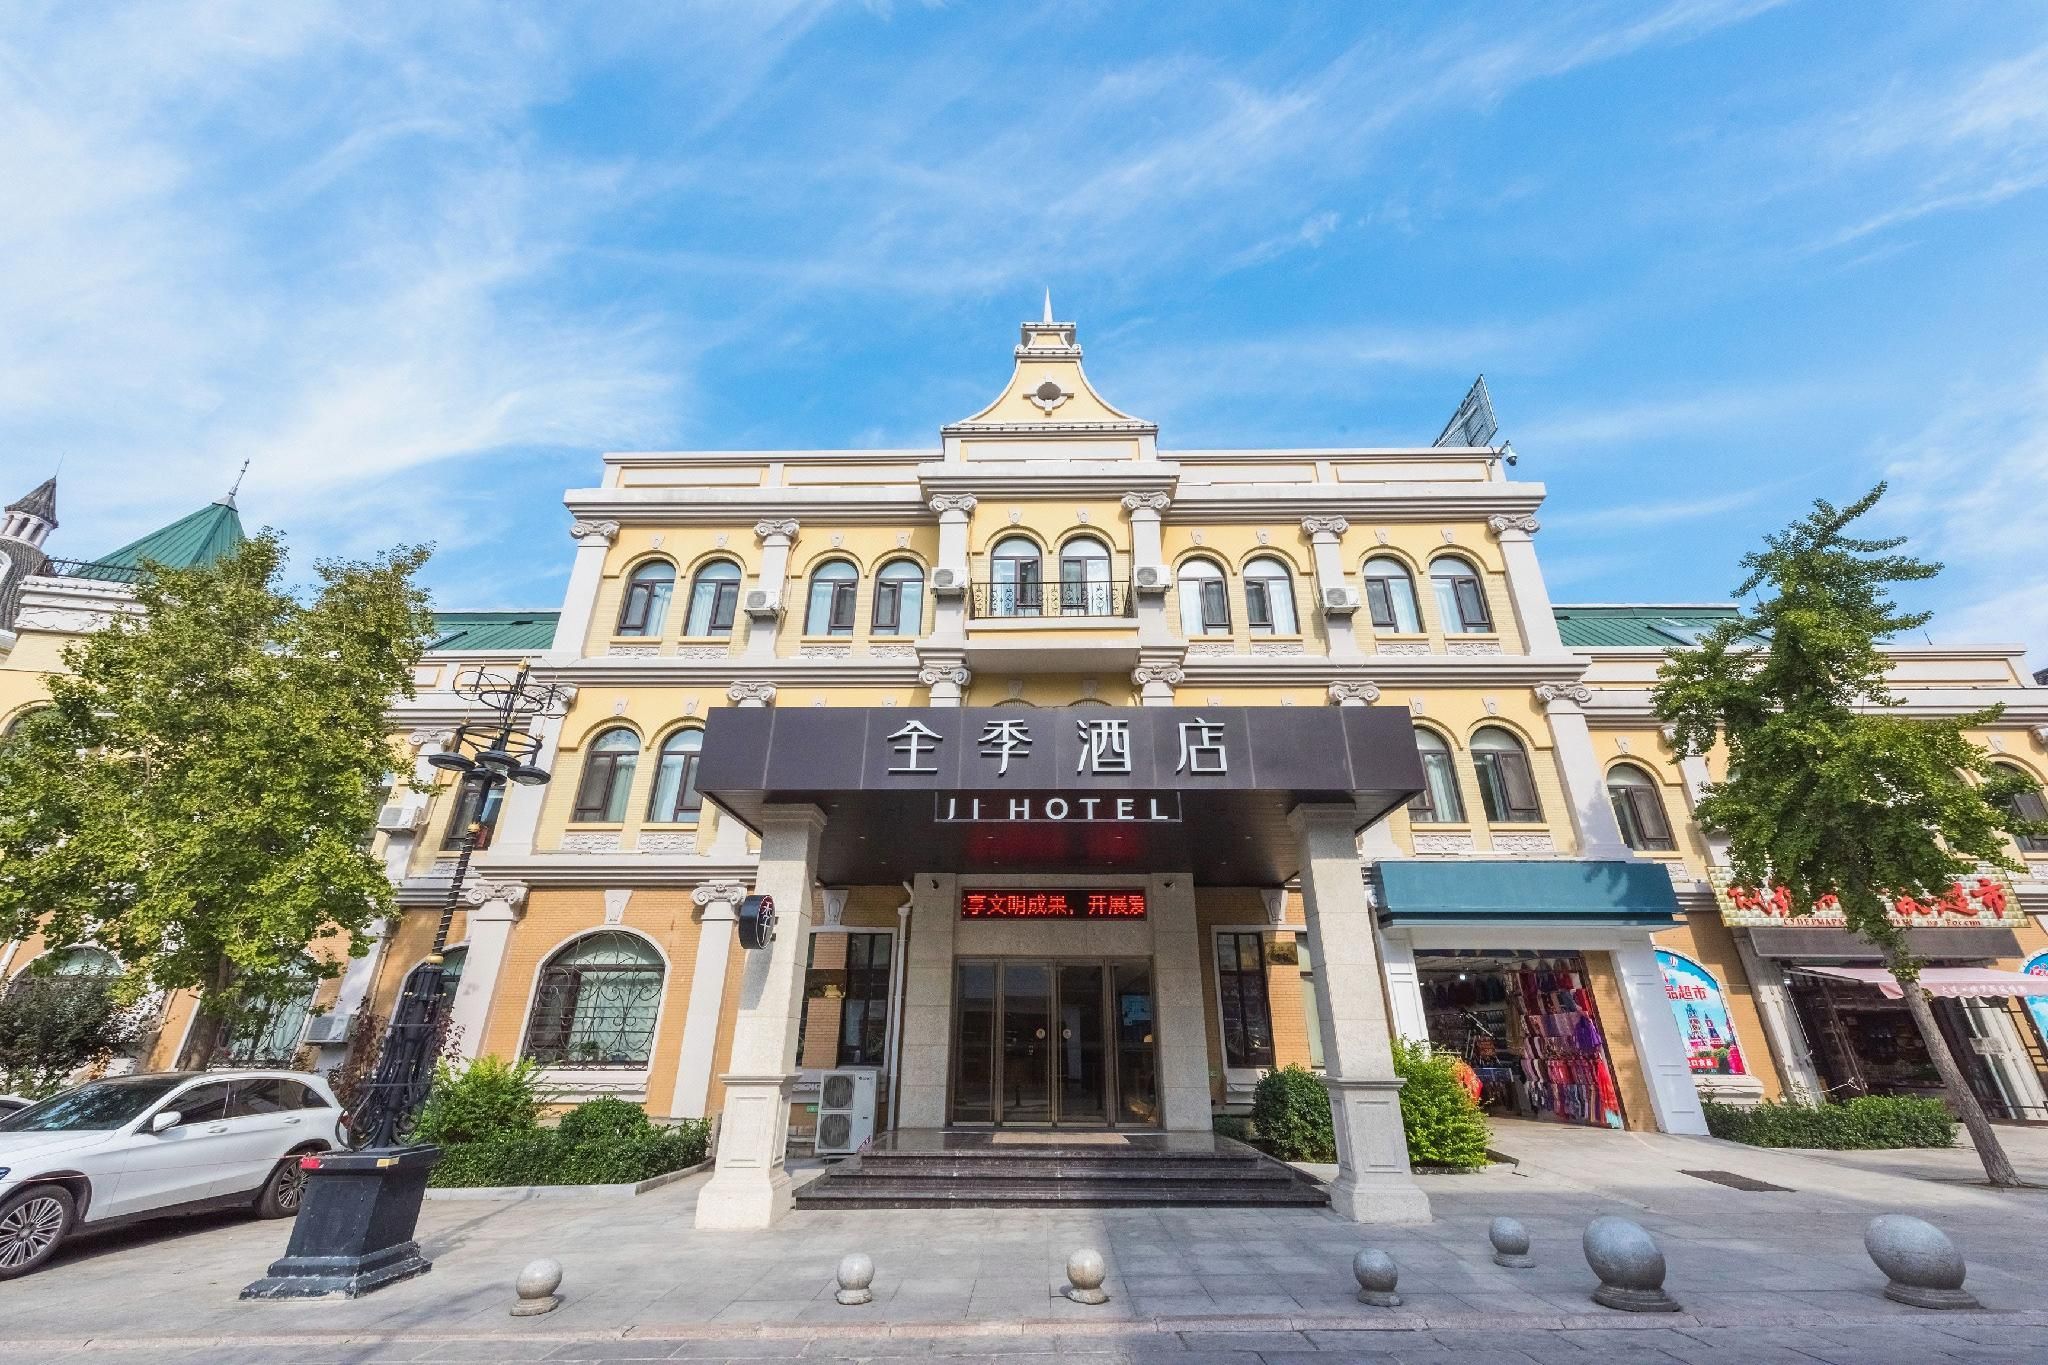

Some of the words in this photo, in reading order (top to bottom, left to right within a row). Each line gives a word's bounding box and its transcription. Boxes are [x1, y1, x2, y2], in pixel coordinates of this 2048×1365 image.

[886, 717, 1229, 776] 全季酒店
[946, 798, 980, 820] JI
[1009, 798, 1169, 820] HOTEL
[963, 894, 1145, 915] 享文明成果，开展爱
[1688, 1058, 1714, 1067] 口食品
